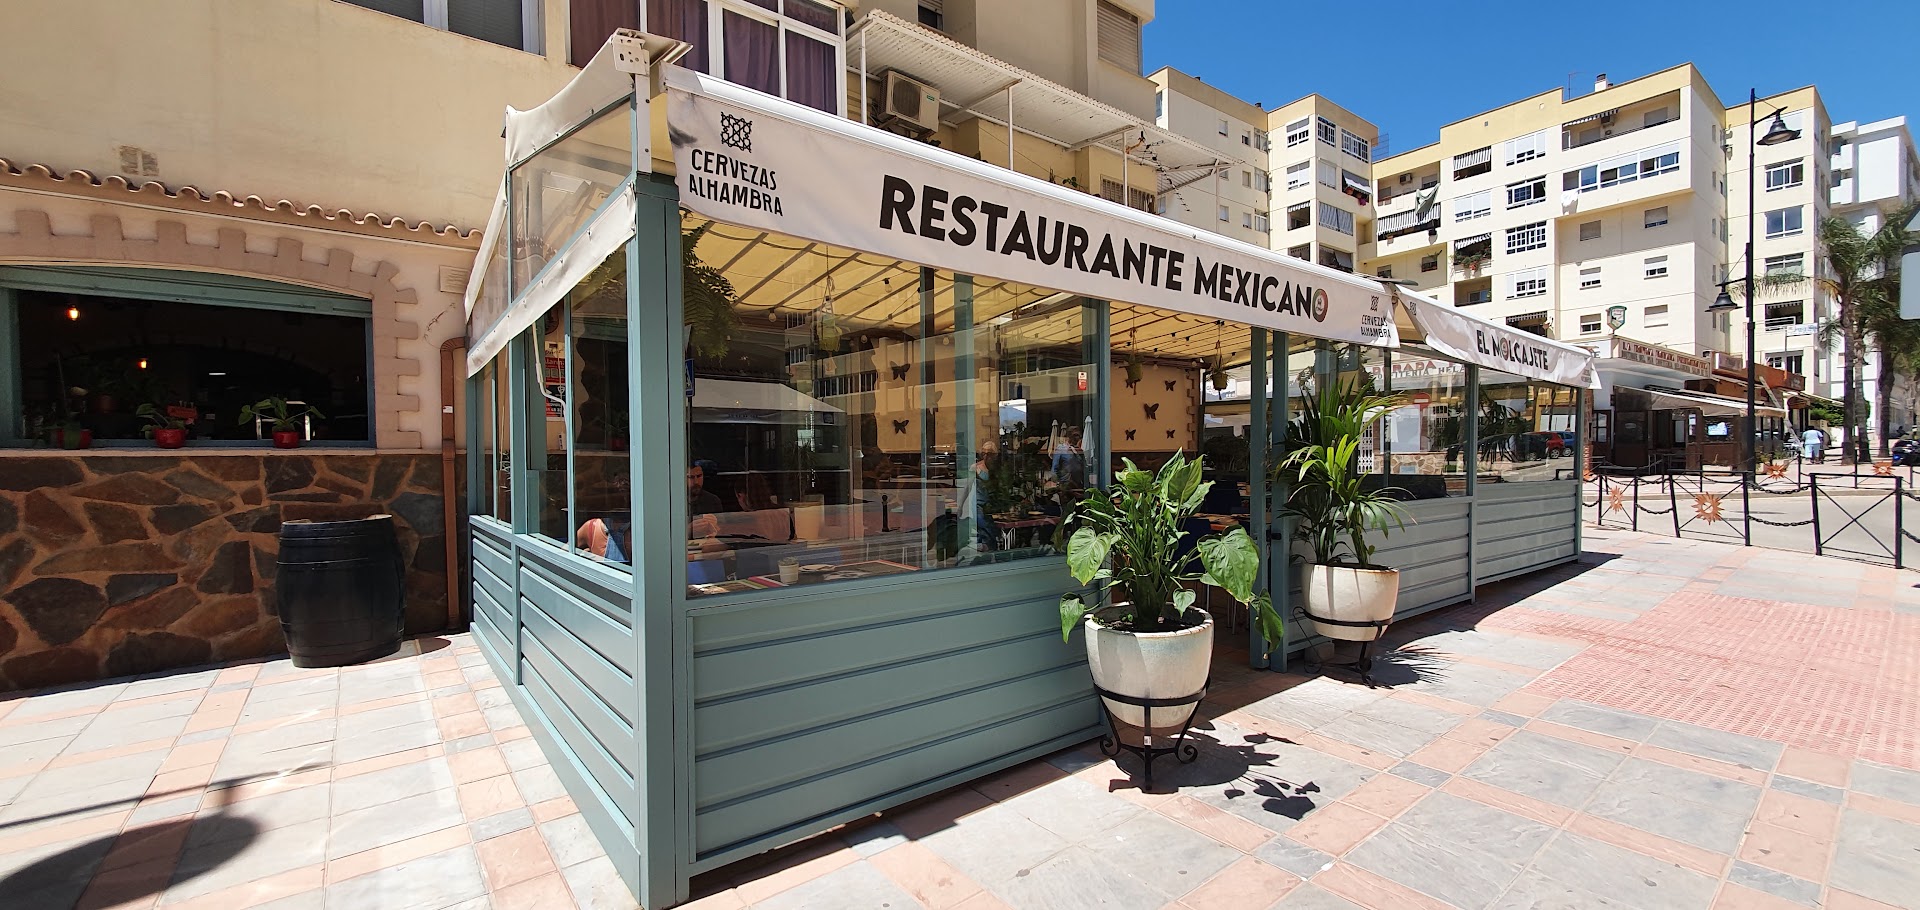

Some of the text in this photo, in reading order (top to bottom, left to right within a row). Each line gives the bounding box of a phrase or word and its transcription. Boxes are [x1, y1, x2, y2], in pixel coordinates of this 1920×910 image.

[691, 149, 777, 191] CERVEZAS
[689, 174, 783, 217] ALHAMBRA
[879, 174, 1329, 323] RESTAURANTE MEXICANO
[1476, 330, 1490, 355] EL
[1372, 361, 1437, 376] DRADA
